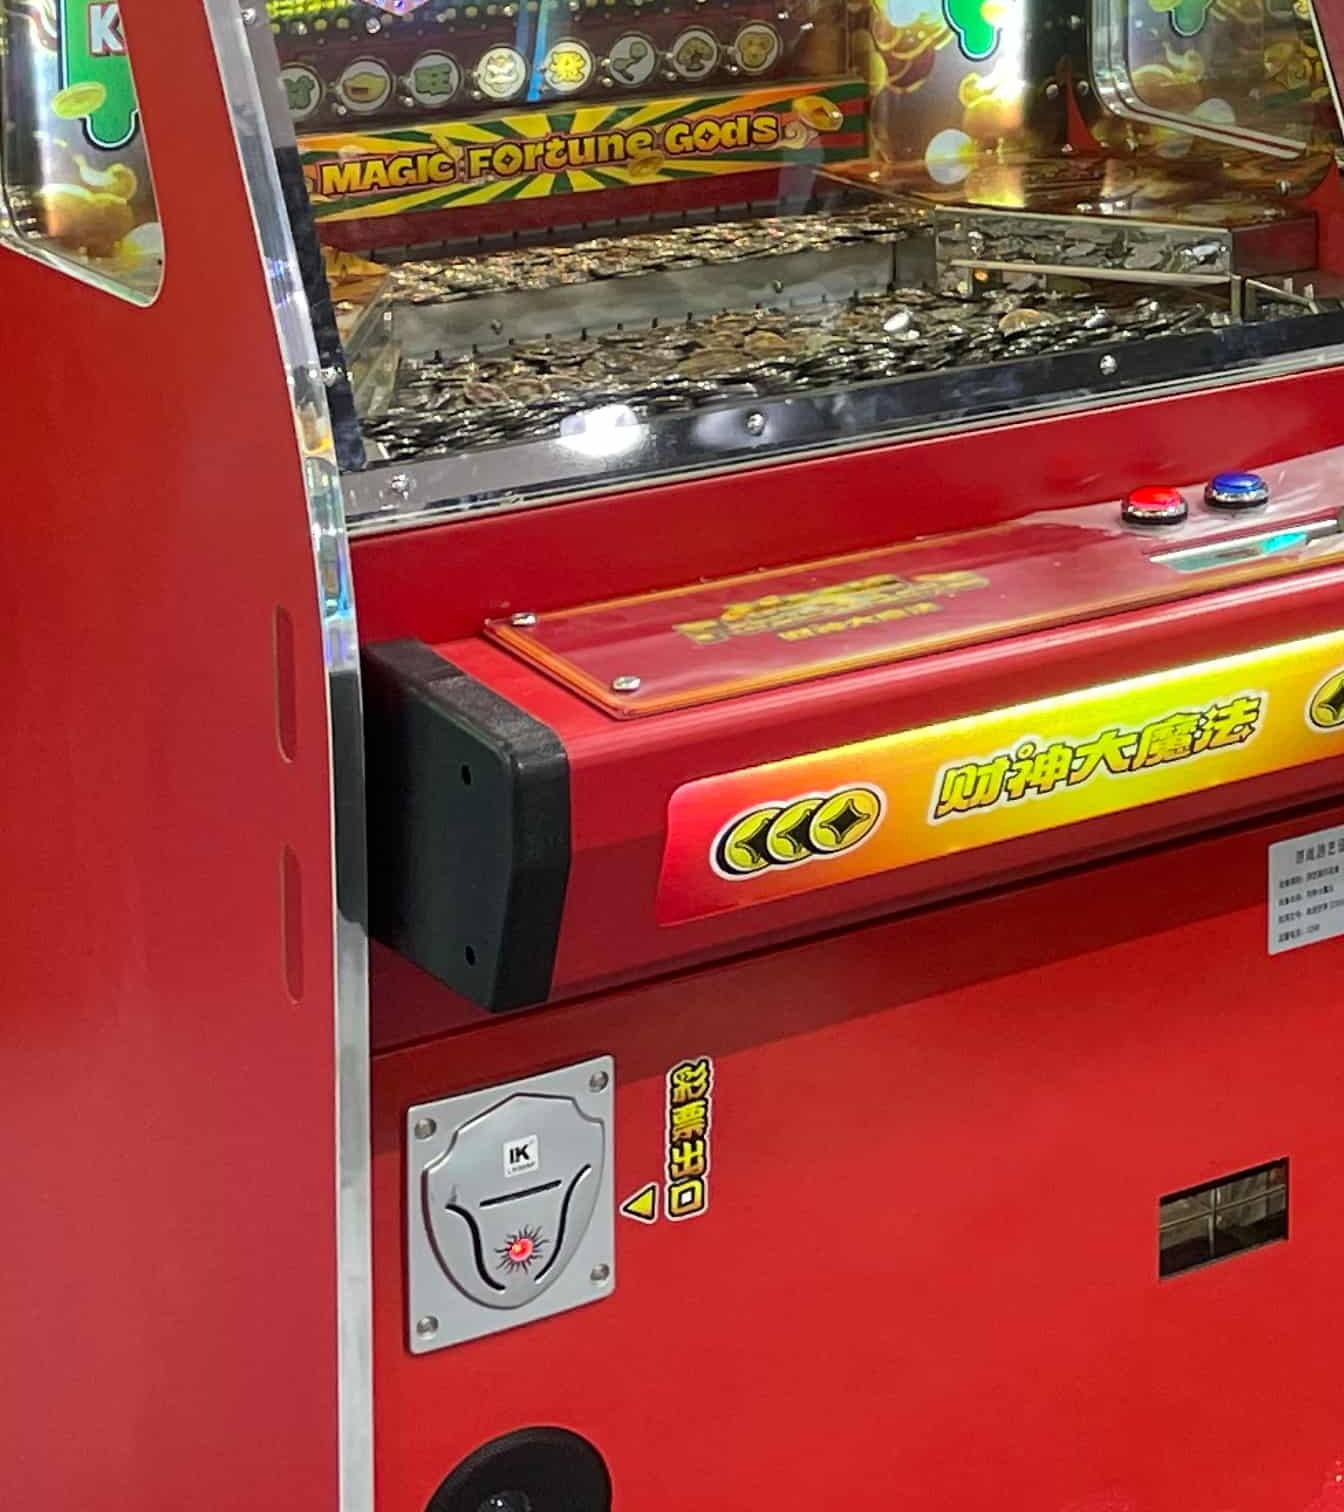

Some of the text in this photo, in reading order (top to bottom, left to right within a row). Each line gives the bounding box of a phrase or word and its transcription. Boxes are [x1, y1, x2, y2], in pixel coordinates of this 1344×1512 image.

[315, 148, 457, 198] MAGIC
[932, 694, 1264, 824] 财神大魔法
[670, 1058, 708, 1217] 彩票出口
